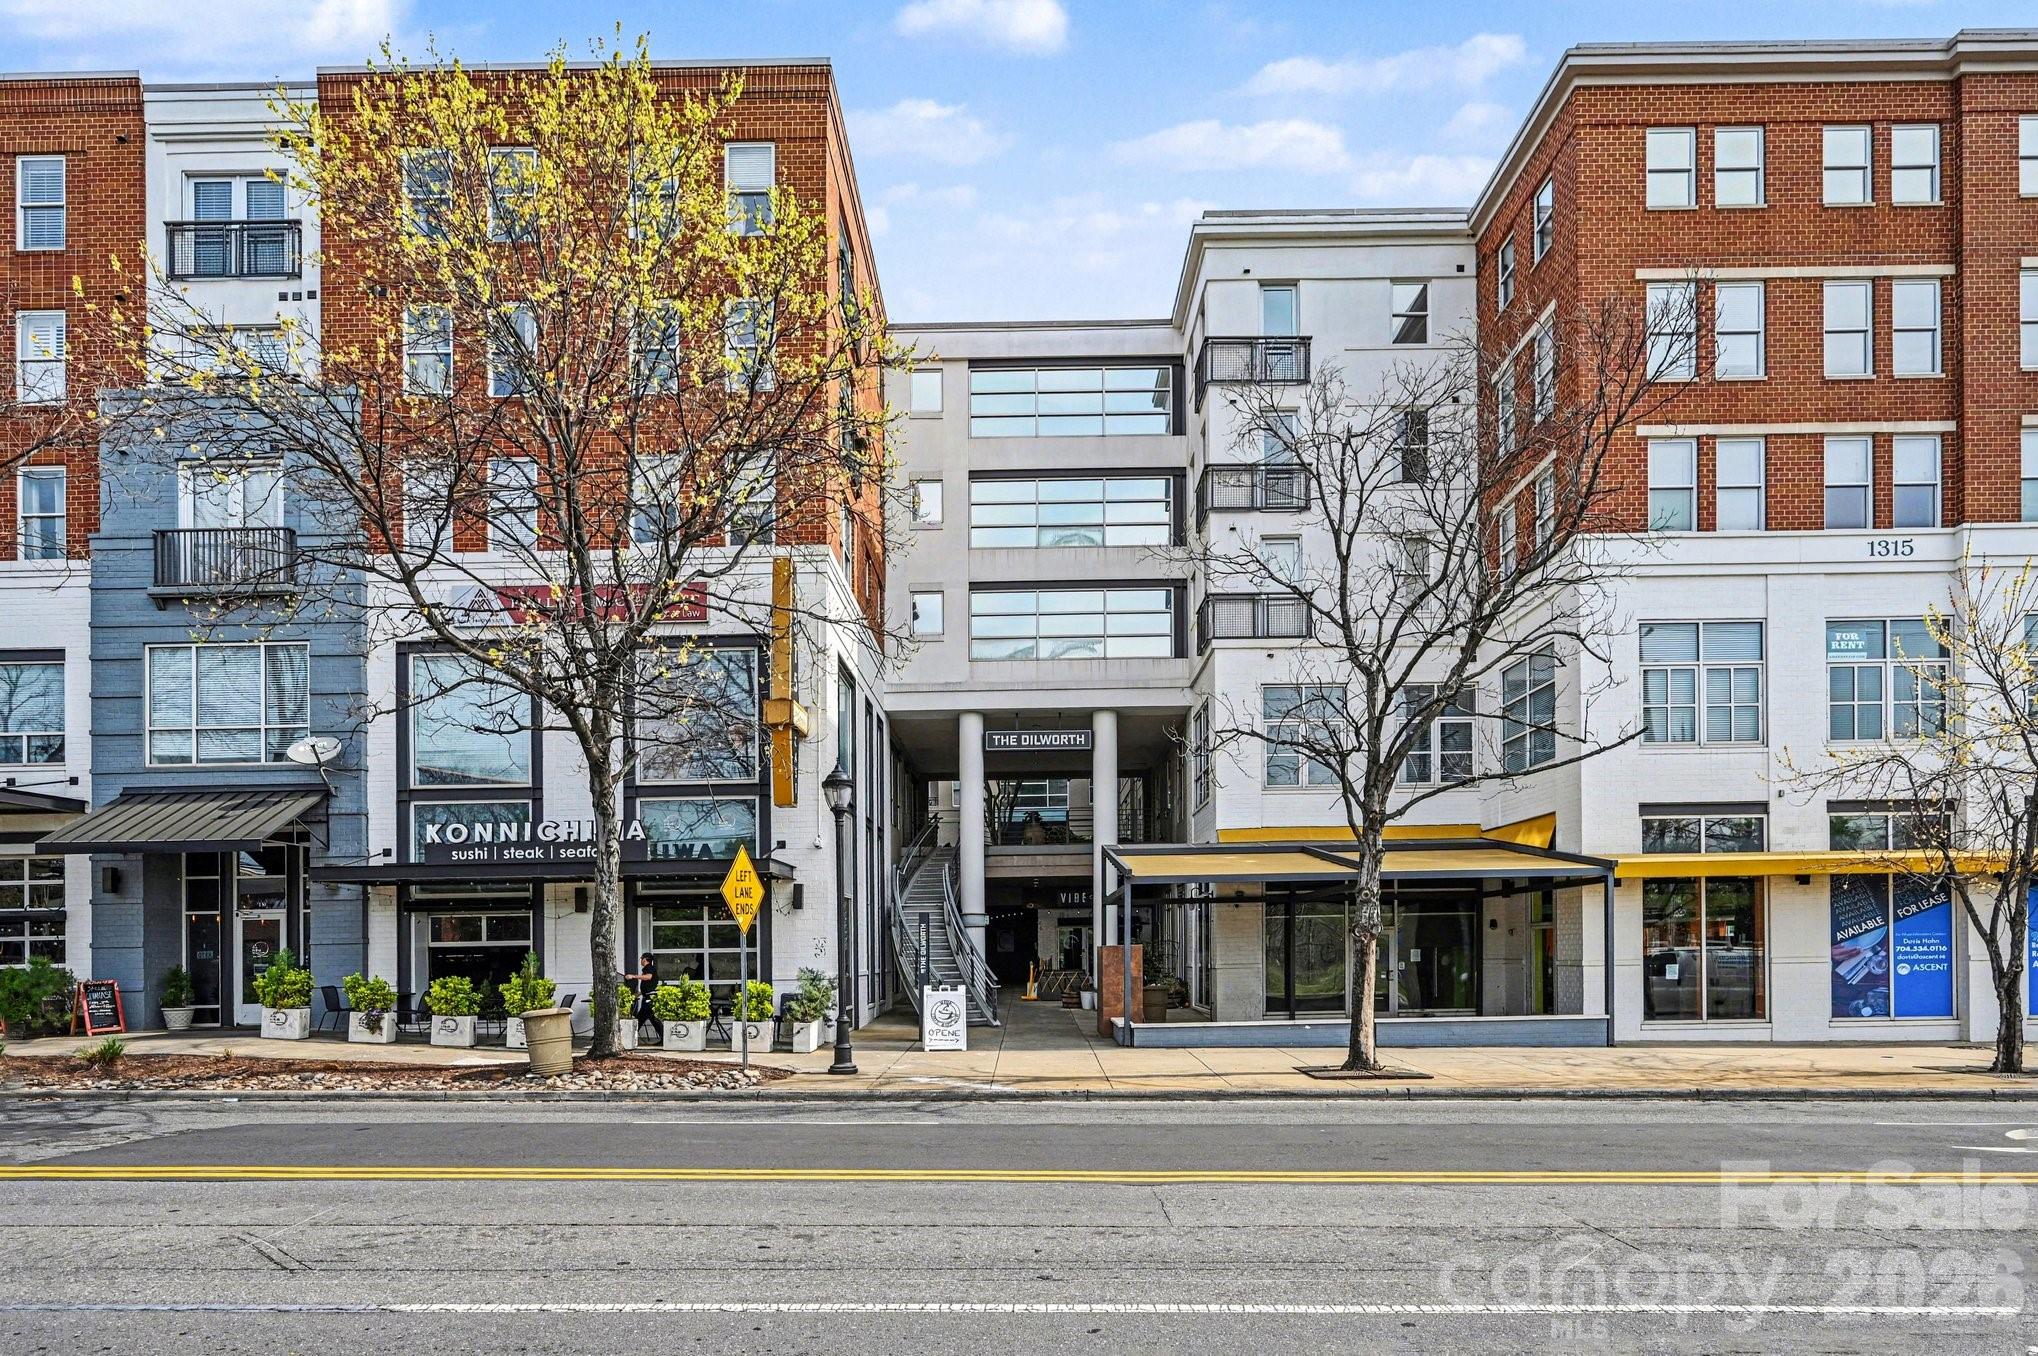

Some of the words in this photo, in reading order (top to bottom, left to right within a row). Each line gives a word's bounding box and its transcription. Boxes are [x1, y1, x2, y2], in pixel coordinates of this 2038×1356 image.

[1867, 538, 1914, 557] 1315
[1835, 632, 1859, 640] FOR
[1831, 641, 1865, 650] RENT
[993, 735, 1018, 746] THE
[1021, 734, 1085, 746] DILWORTH
[425, 819, 647, 844] KONNICHIA
[451, 847, 488, 860] sushi
[503, 846, 545, 859] steak
[735, 870, 752, 882] LEFT
[734, 886, 753, 899] LANE
[735, 903, 754, 915] ENDS
[1896, 904, 1920, 918] FOR
[1918, 892, 1949, 910] LEASE
[1836, 916, 1885, 941] AVAILABLE
[1912, 963, 1948, 971] ASCENT
